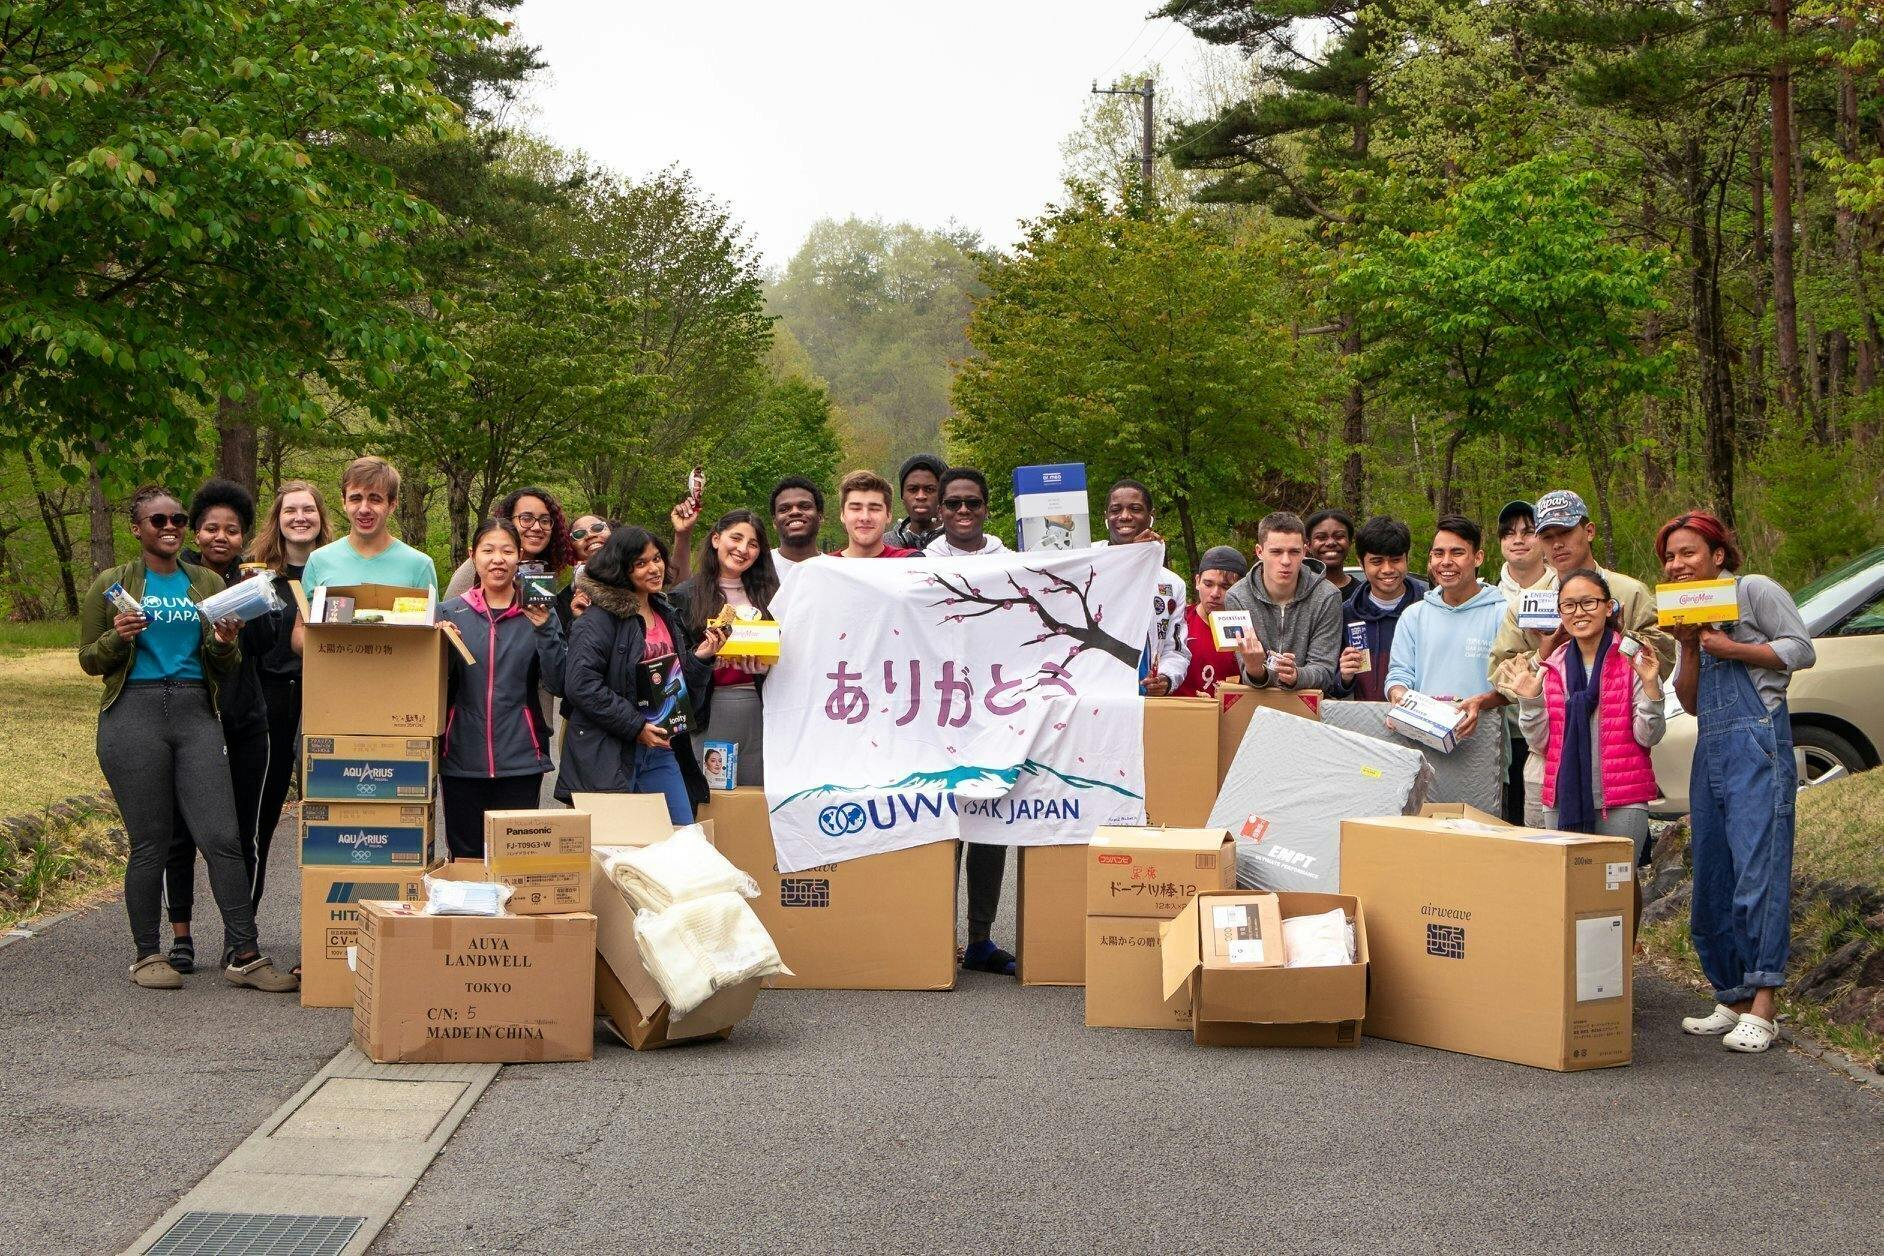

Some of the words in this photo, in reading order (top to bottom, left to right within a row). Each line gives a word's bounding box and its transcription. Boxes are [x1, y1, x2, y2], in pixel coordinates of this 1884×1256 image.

[1538, 496, 1568, 514] Japan
[163, 597, 195, 607] UW
[1523, 595, 1538, 612] in
[165, 610, 200, 623] JAPA
[318, 643, 393, 655] 太陽からの贈り物
[1202, 665, 1215, 690] 9
[825, 660, 1077, 728] ありがとう
[343, 763, 394, 782] AQUARIUS
[1006, 798, 1080, 825] JAPAN
[506, 827, 552, 836] Panasonic
[338, 830, 389, 849] AQUARIUS
[506, 841, 551, 850] FJ-T09G3-W
[1267, 845, 1317, 869] EMPT
[1155, 902, 1188, 910] 12本入×2
[1421, 902, 1471, 920] airweave
[468, 938, 509, 950] AUYA
[445, 954, 532, 968] LANDWELL
[464, 982, 512, 993] TOKYO
[427, 1007, 458, 1021] C/N:
[467, 1005, 477, 1020] 5
[426, 1026, 472, 1039] MADE
[475, 1027, 491, 1039] IN
[495, 1027, 544, 1039] CHINA
